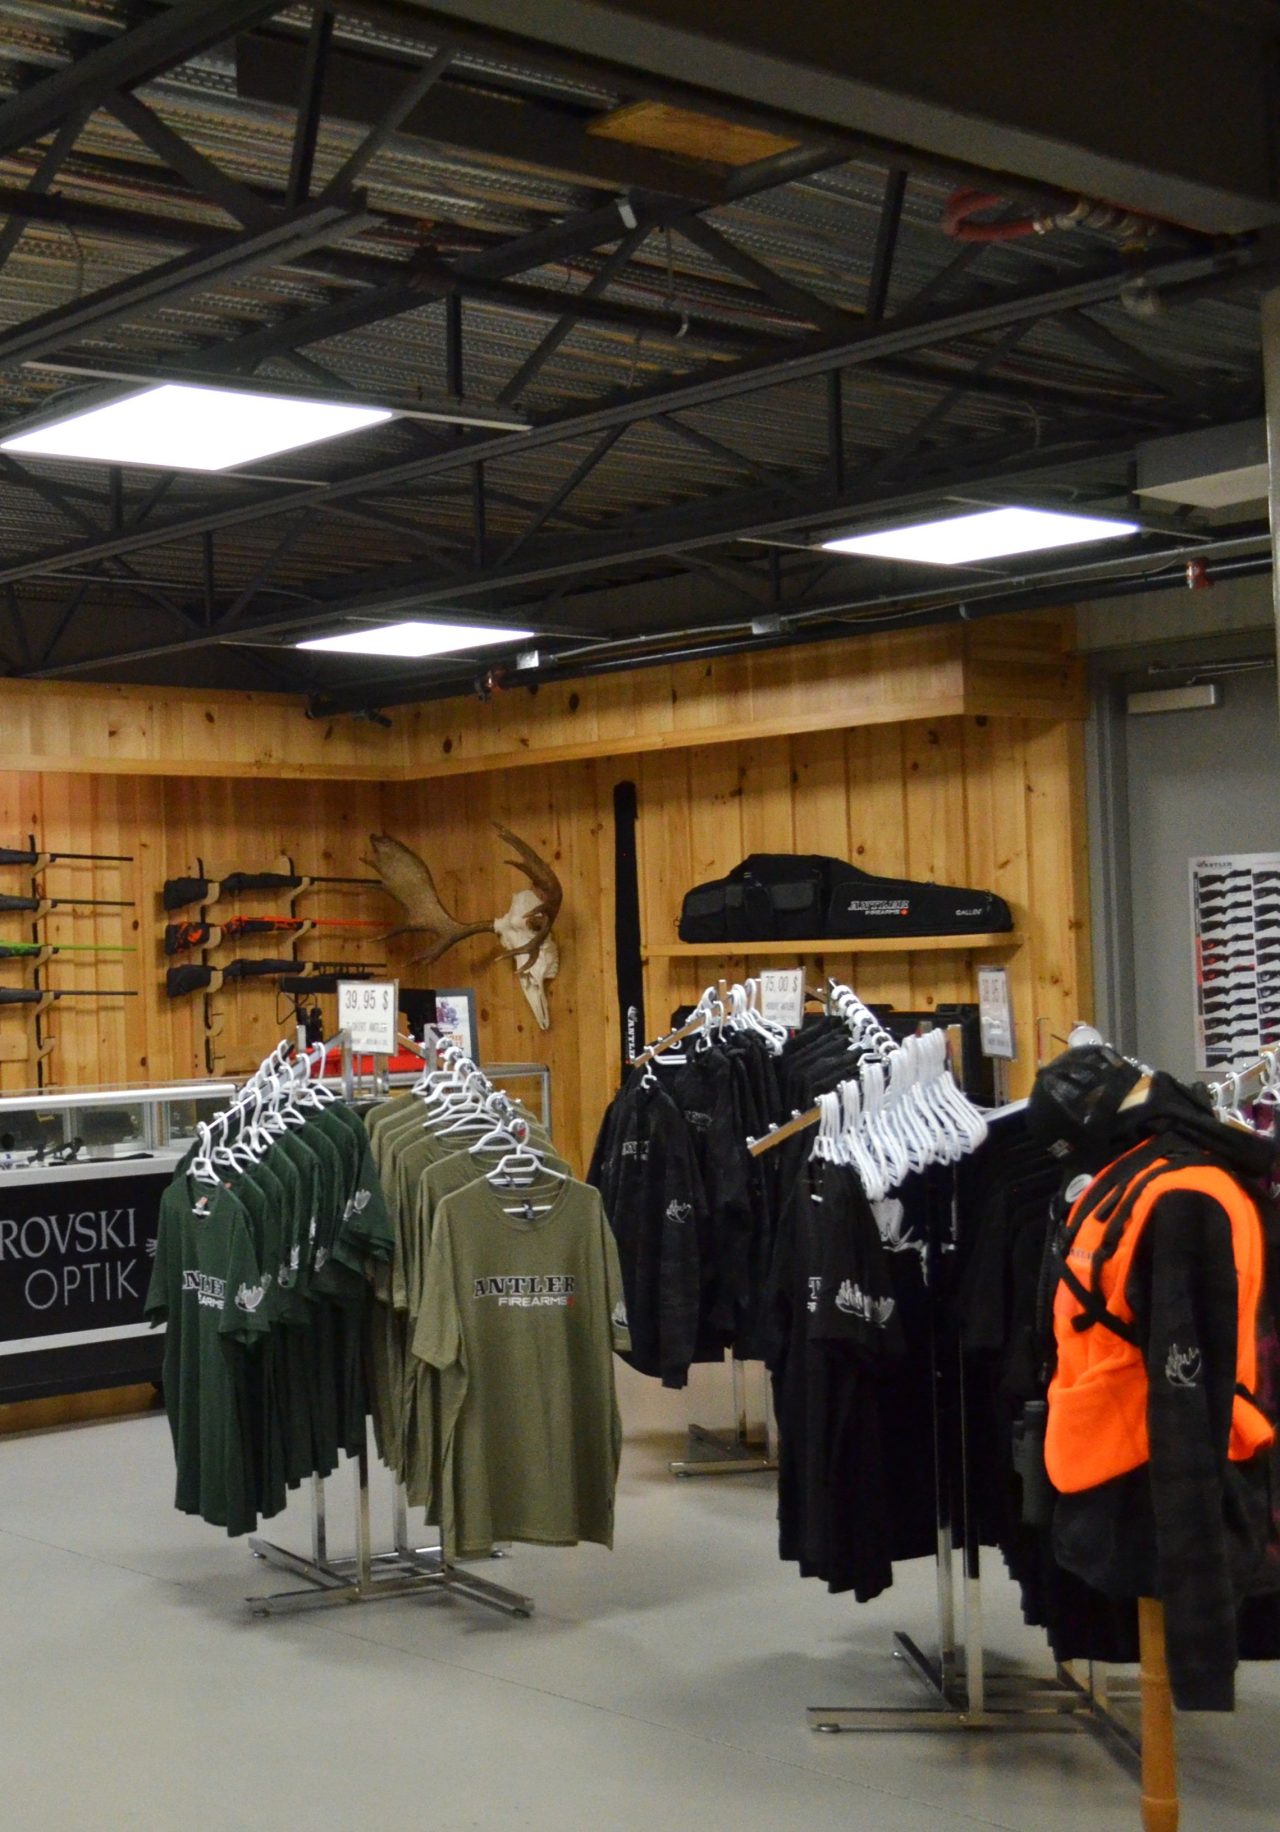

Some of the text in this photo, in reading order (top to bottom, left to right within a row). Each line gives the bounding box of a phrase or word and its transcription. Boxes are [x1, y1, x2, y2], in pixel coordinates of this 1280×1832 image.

[382, 989, 389, 1011] $
[24, 1258, 139, 1310] OPTIK
[473, 1274, 576, 1299] ANTLER
[498, 1296, 568, 1307] FIREARMS
